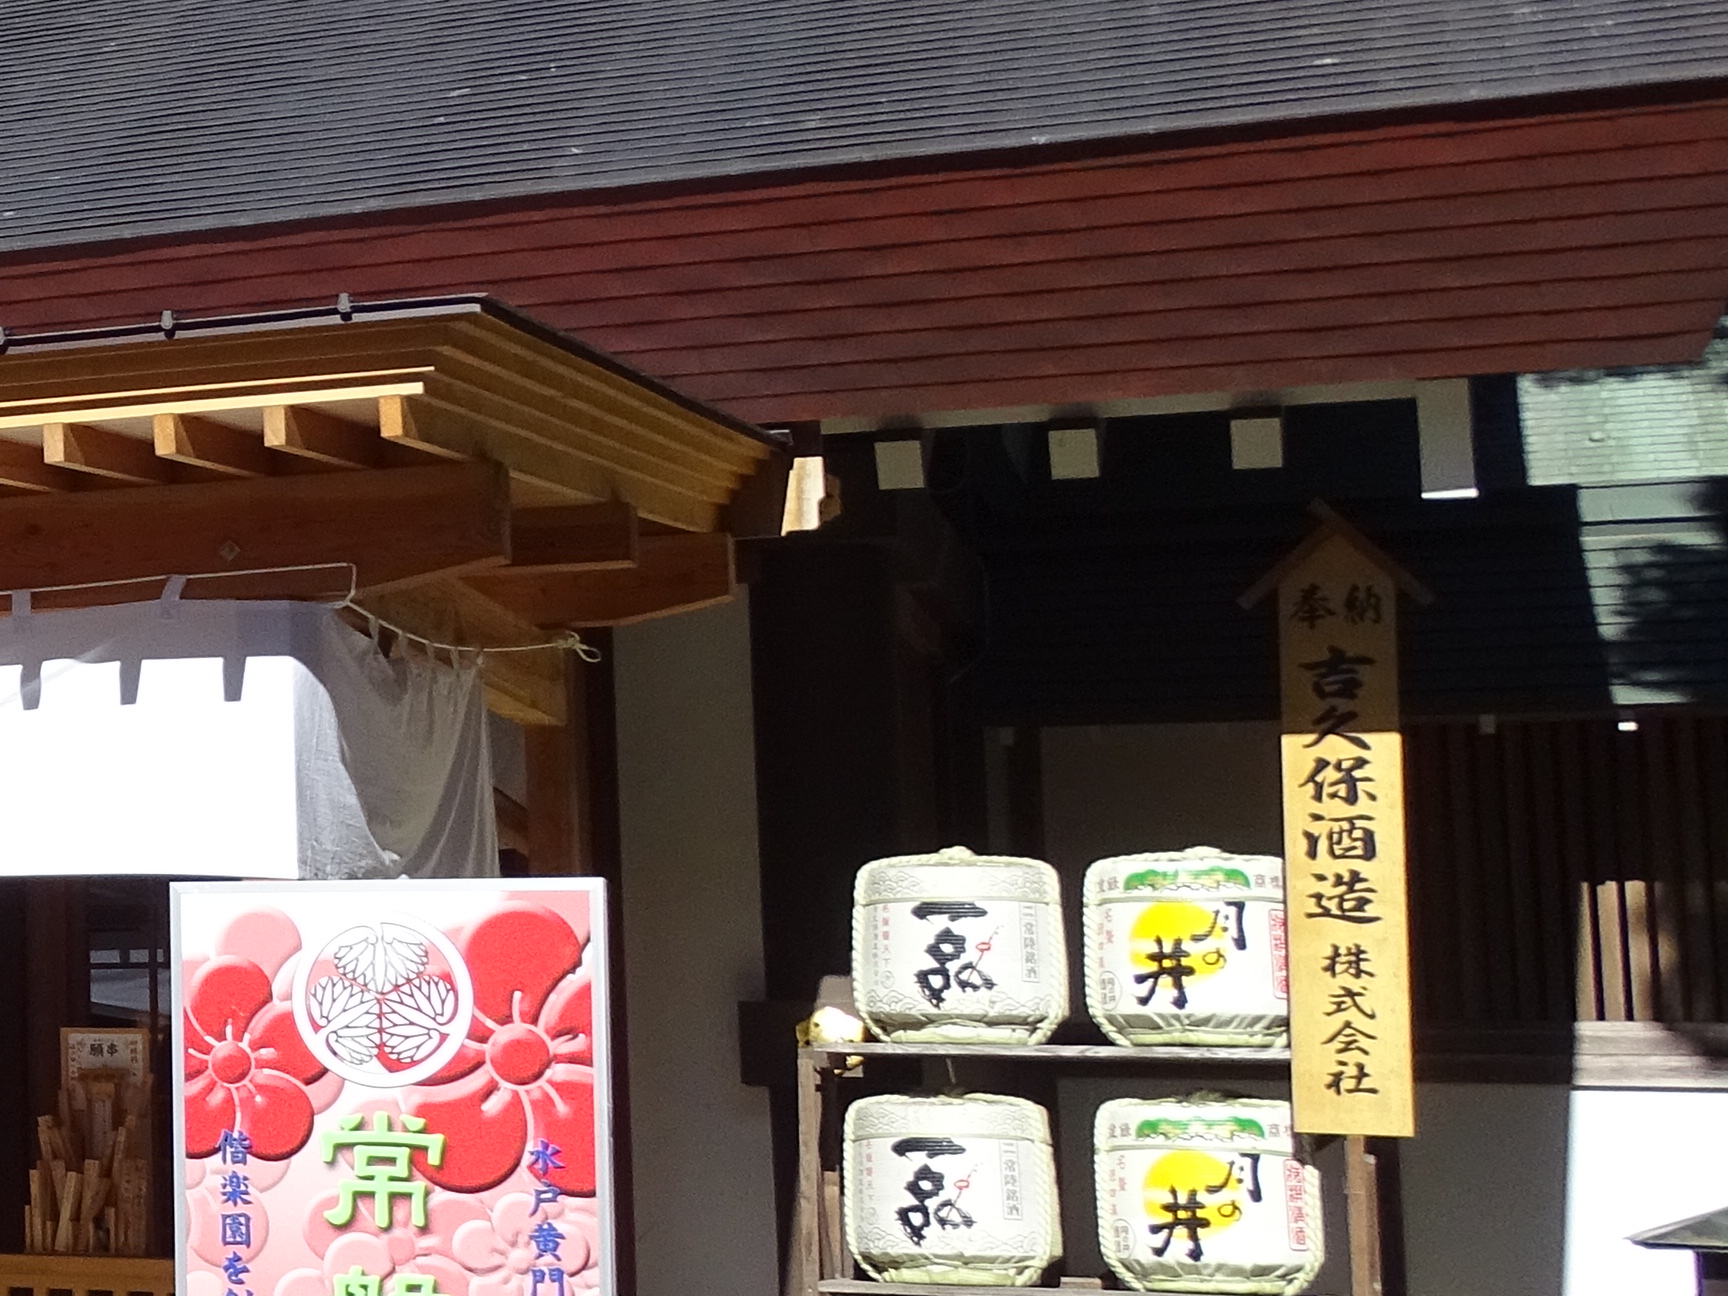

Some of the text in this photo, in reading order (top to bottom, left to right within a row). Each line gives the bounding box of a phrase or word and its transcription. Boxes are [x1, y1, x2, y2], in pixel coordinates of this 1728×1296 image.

[1292, 582, 1384, 630] 奉納
[1297, 644, 1383, 1097] 吉久保酒造 株式会社
[1131, 899, 1247, 1010] 月の井
[1146, 1152, 1263, 1262] 月の井
